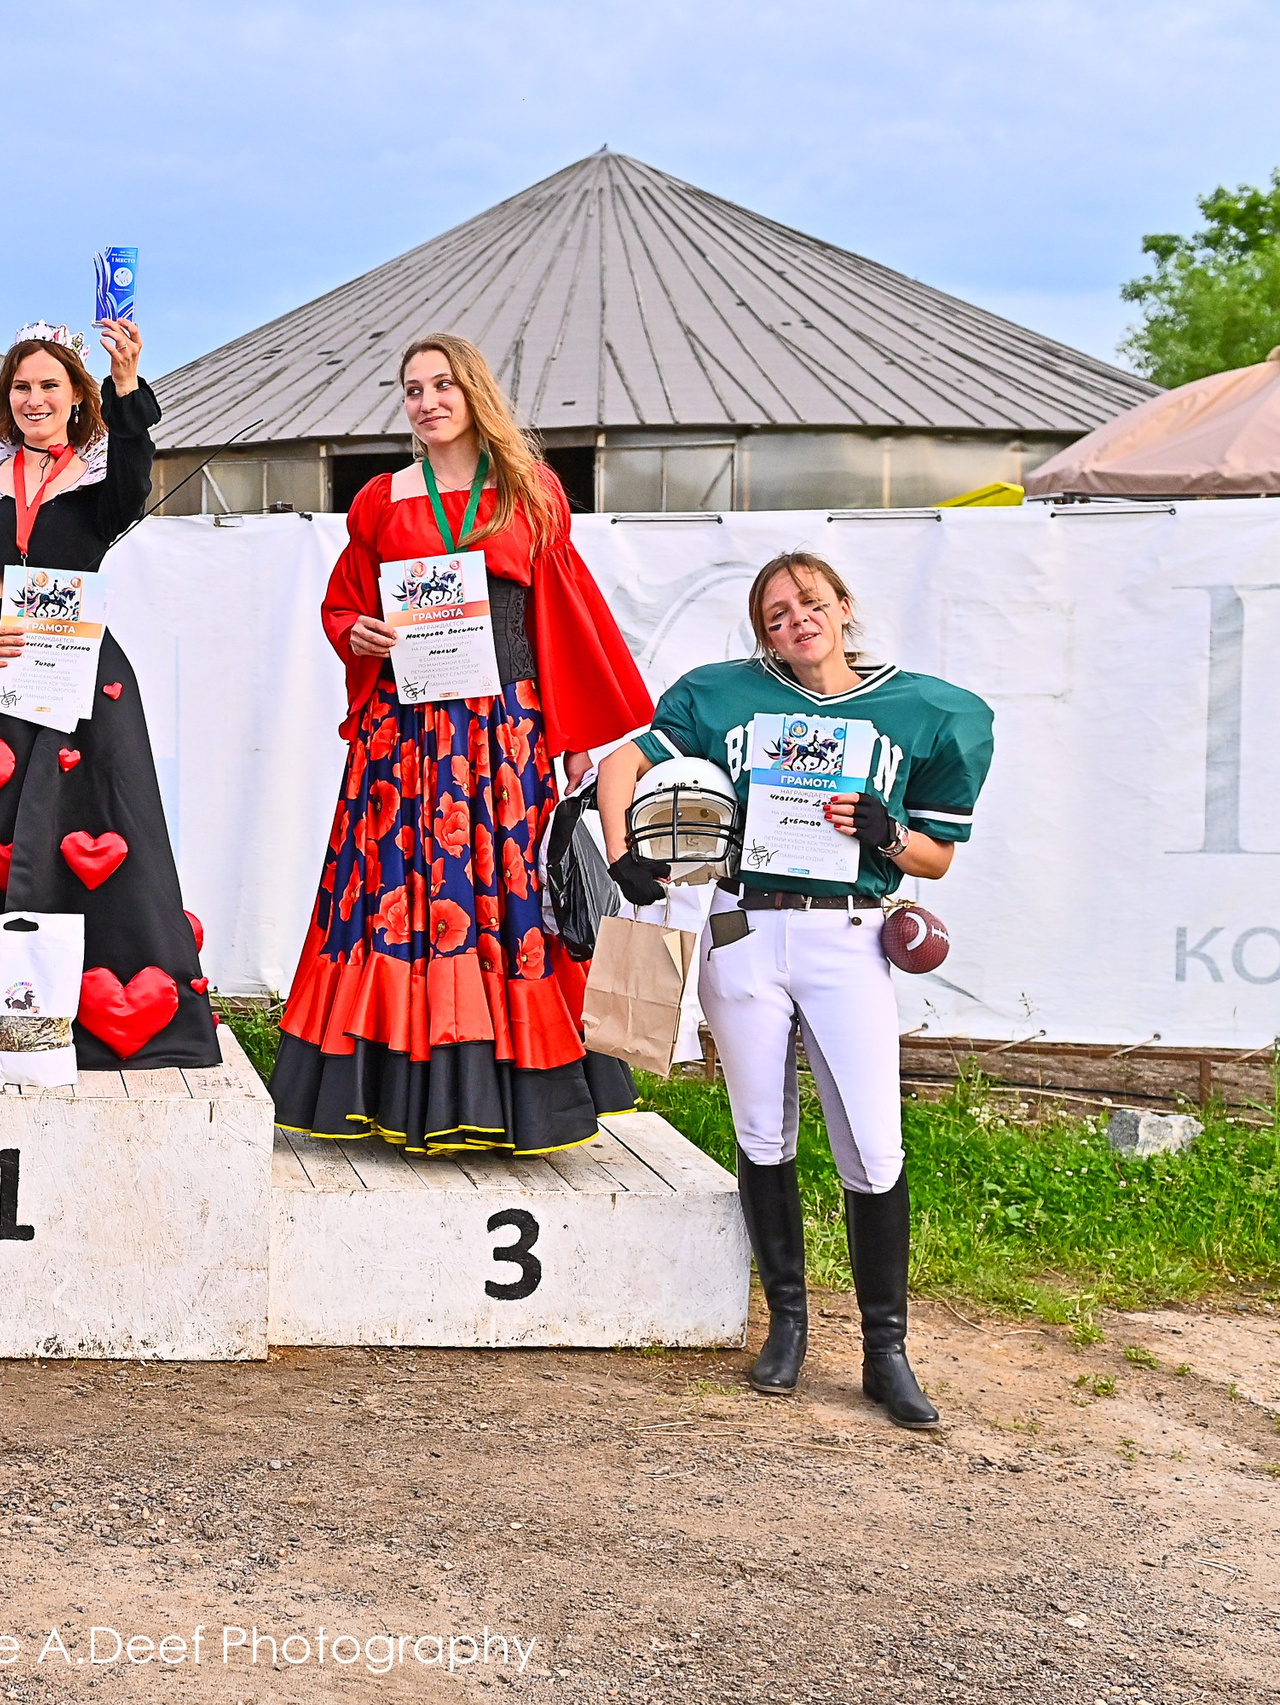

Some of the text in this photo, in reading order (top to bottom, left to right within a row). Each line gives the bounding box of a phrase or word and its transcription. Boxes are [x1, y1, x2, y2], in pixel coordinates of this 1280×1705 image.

[412, 607, 463, 621] ГРАМОТА
[26, 622, 75, 633] ГРАМОТА
[780, 775, 837, 788] ГРАМОТА
[779, 789, 831, 799] НАГРАЖДАЕТС
[484, 1208, 542, 1301] 3
